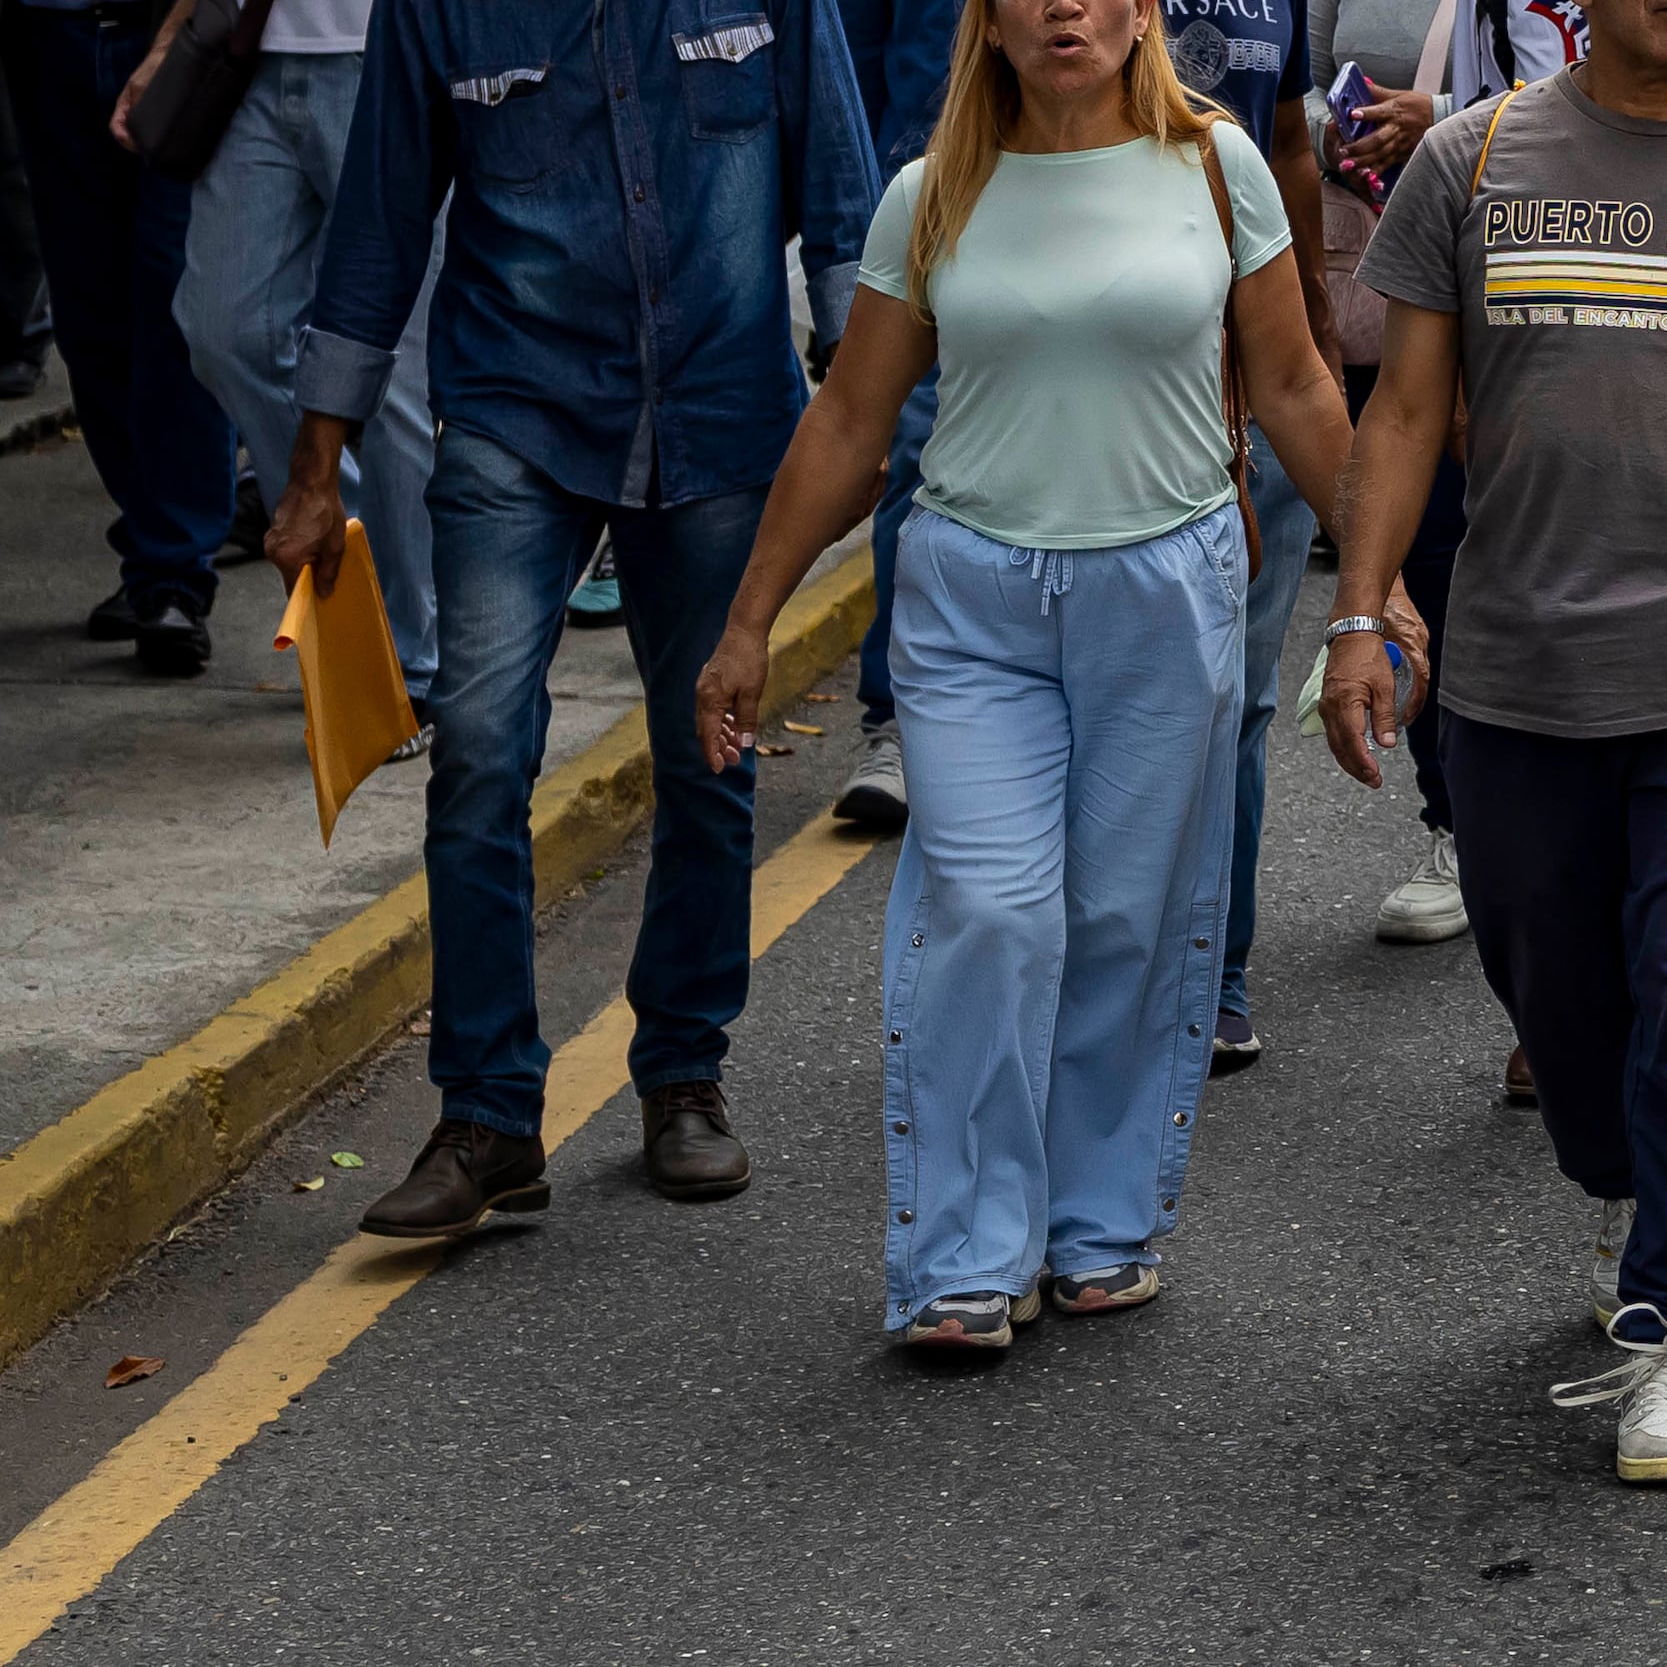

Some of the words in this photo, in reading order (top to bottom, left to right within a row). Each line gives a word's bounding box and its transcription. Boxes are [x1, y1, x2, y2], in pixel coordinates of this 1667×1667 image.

[1484, 199, 1654, 248] PUERTO
[1487, 307, 1525, 327] ISLA
[1530, 308, 1568, 326] DEL
